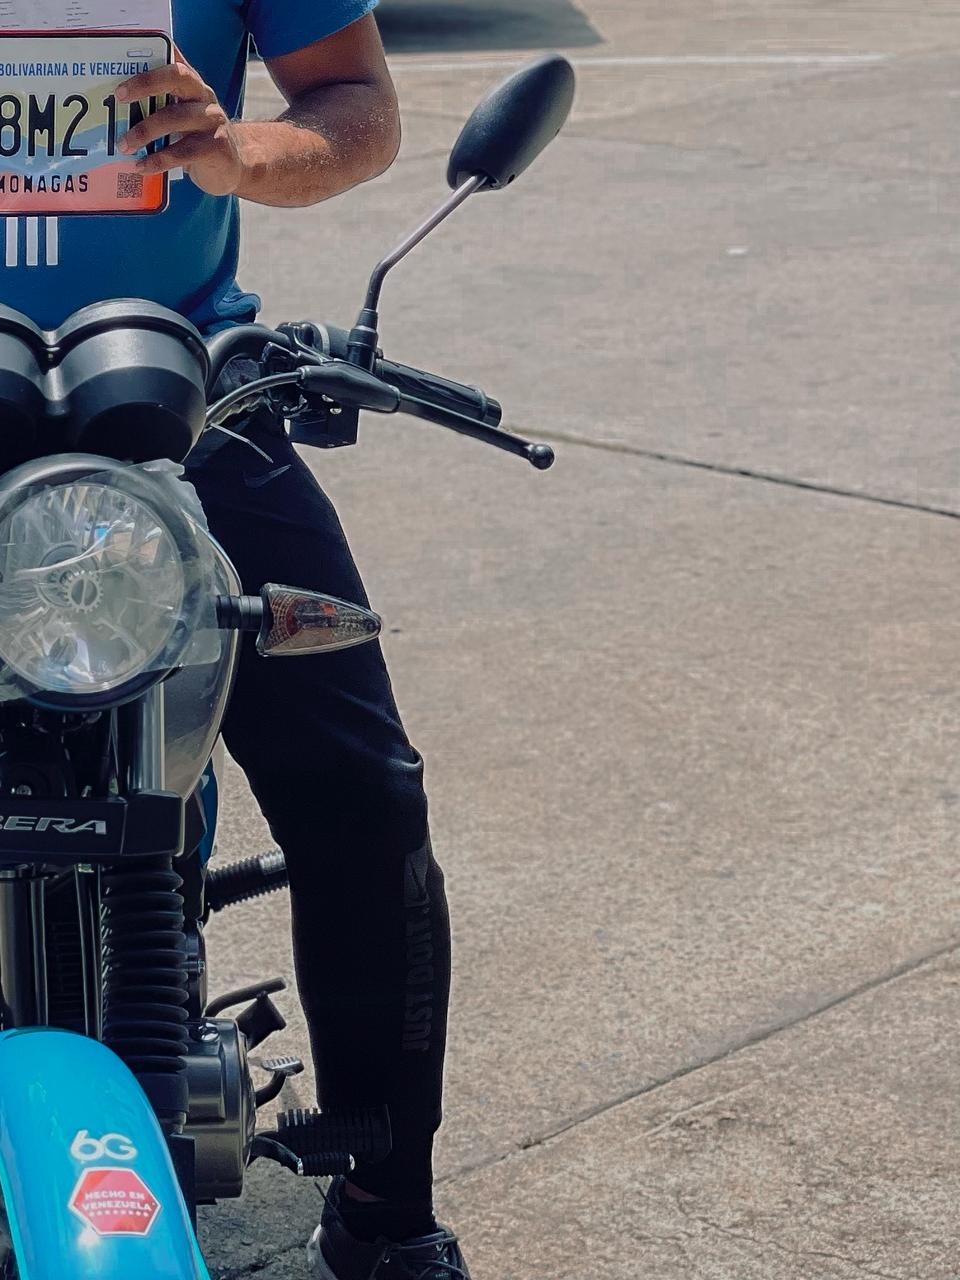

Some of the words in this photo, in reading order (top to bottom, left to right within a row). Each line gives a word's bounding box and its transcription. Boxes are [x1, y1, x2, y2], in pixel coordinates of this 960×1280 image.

[72, 62, 86, 76] DE
[89, 62, 149, 76] VENEZUELA
[85, 1190, 126, 1200] HECHO
[129, 1191, 145, 1200] EN
[81, 1200, 152, 1211] VENEZUELA
